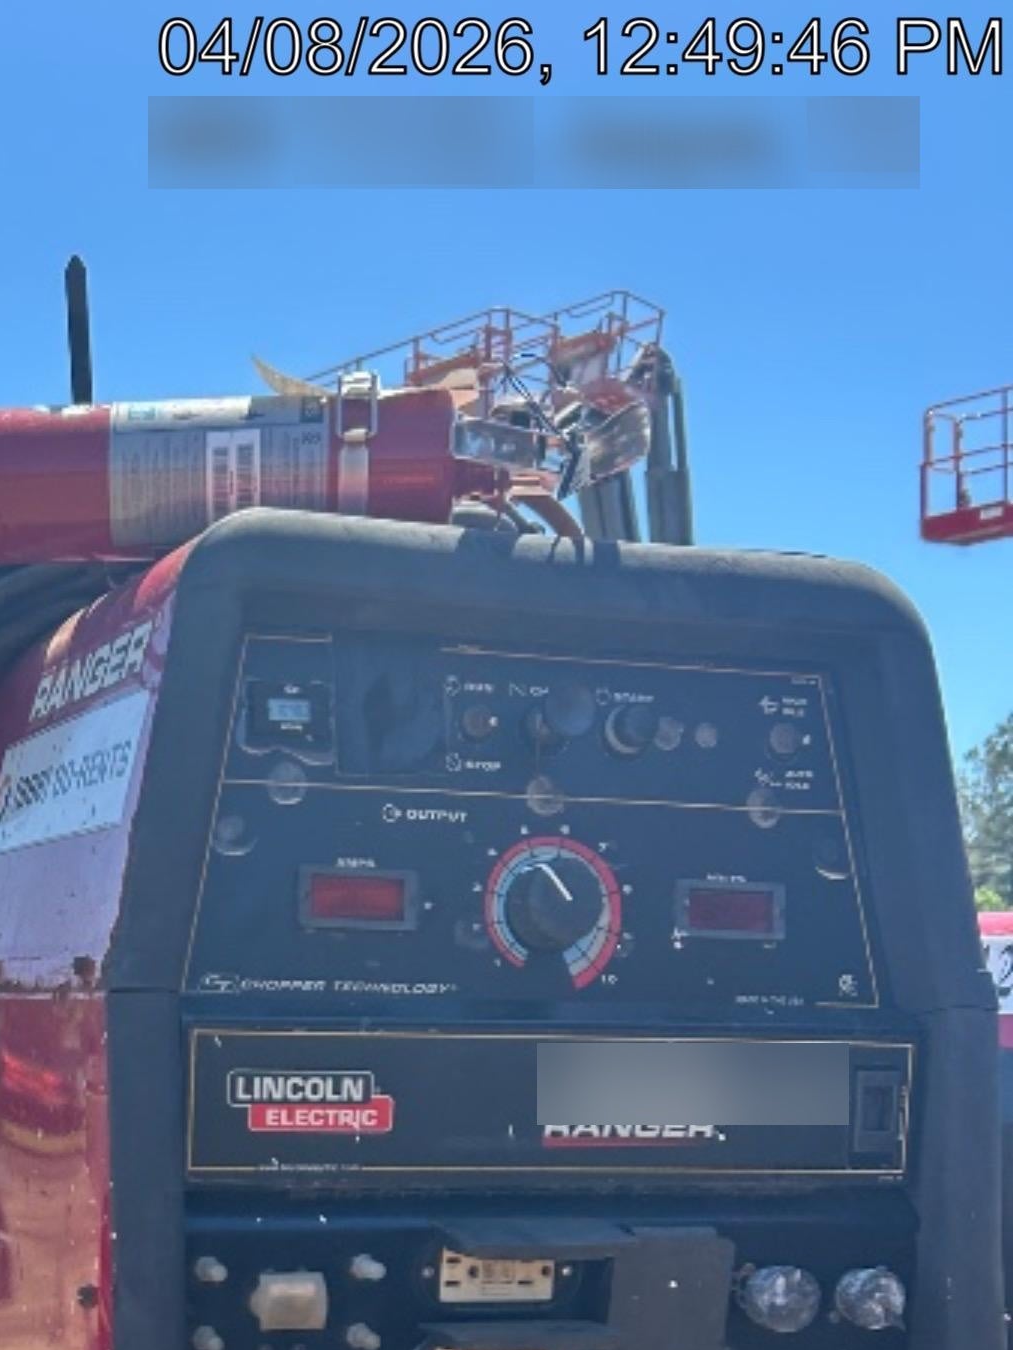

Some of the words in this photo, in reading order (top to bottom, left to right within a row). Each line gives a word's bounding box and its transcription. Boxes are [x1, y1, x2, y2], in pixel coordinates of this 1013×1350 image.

[28, 620, 154, 724] RANGER
[406, 808, 468, 824] OUTPUT
[240, 978, 327, 992] CHOPPER
[333, 979, 452, 995] TECHNOLOGY
[236, 1075, 364, 1103] LINCOLN
[265, 1108, 379, 1127] ELECTRIC
